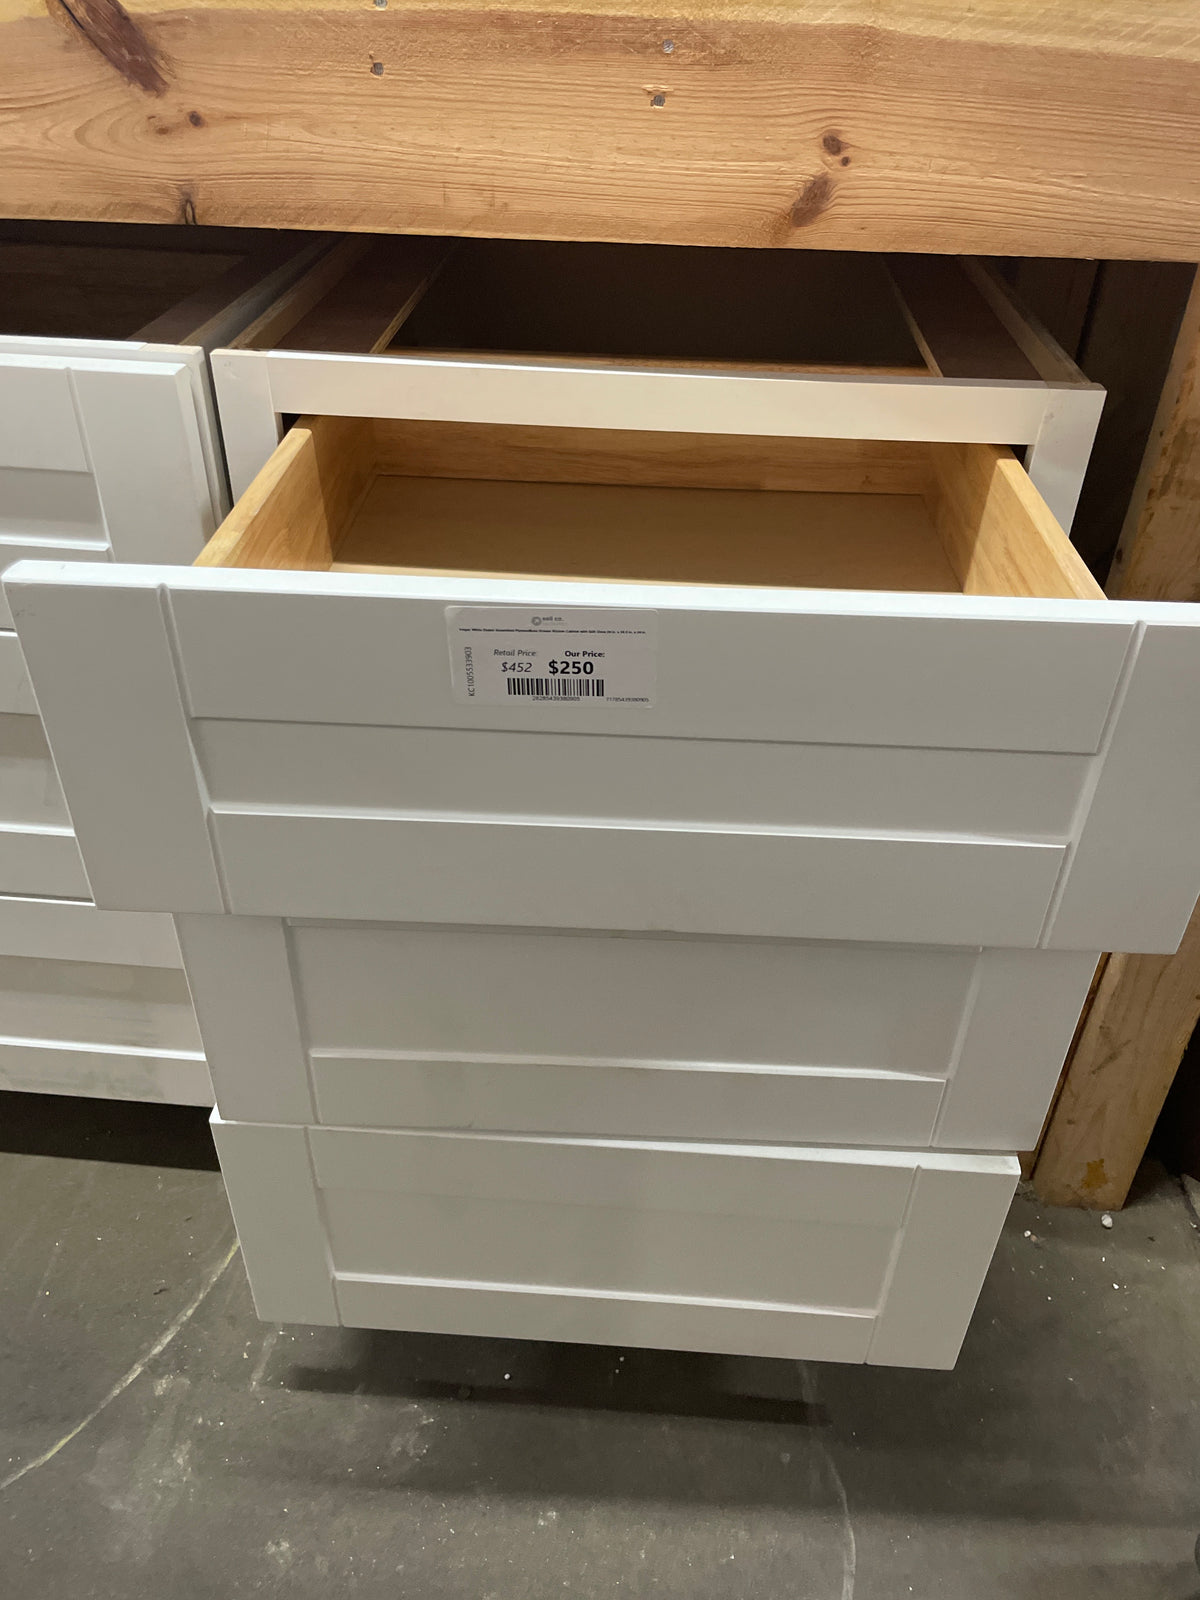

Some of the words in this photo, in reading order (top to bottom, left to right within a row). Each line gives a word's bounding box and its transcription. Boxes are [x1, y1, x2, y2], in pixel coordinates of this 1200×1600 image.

[493, 649, 515, 657] Retail
[501, 662, 533, 673] $452
[548, 660, 594, 676] $250
